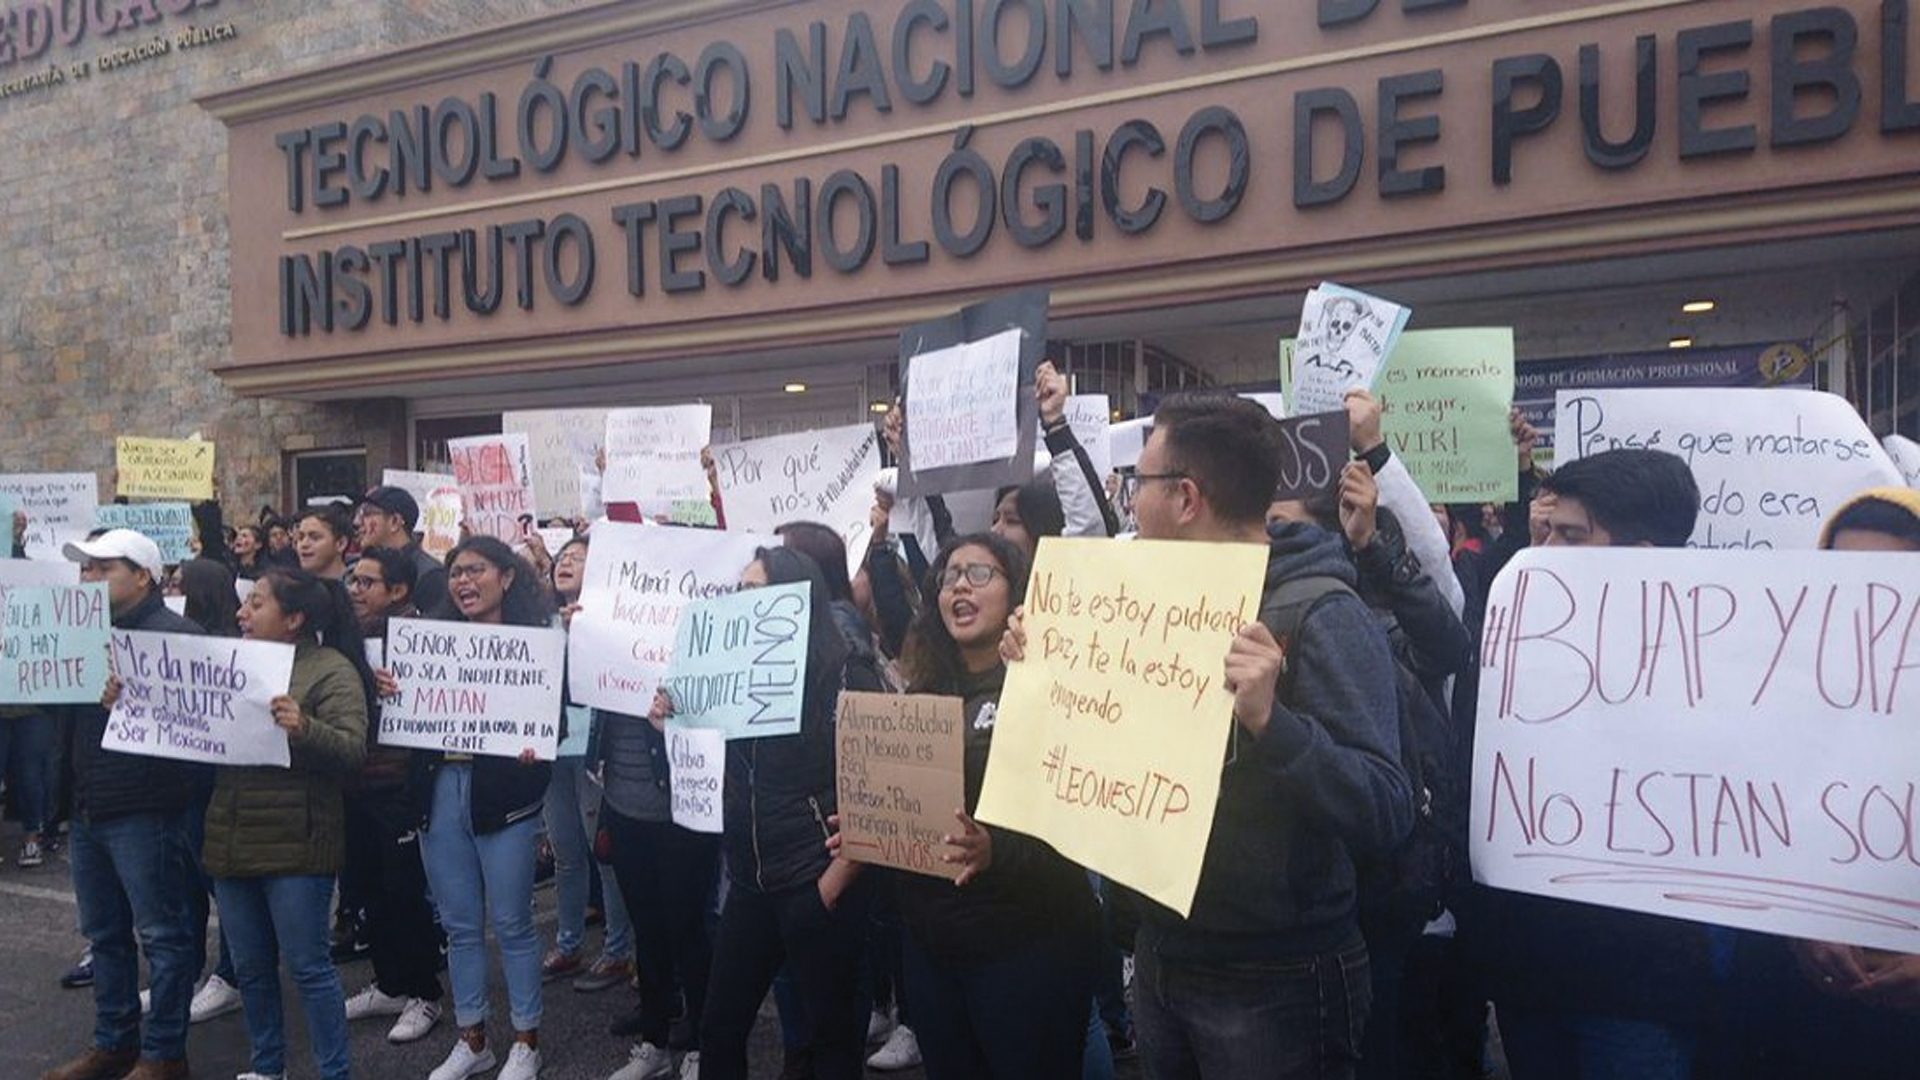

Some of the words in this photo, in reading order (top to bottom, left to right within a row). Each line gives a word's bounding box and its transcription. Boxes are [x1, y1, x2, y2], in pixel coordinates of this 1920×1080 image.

[276, 41, 750, 213] TECNOLÓGICO
[279, 212, 596, 337] INSTITUTO
[612, 105, 1250, 297] TECNOLÓGICO
[1294, 69, 1445, 209] DE
[1417, 359, 1501, 380] momento
[1570, 366, 1645, 384] FORMACIÓN
[1649, 360, 1739, 380] PROFESIONAL
[1678, 433, 1732, 465] que
[1746, 415, 1871, 461] matarse
[783, 442, 821, 492] qué
[770, 491, 811, 514] nos
[1704, 479, 1744, 515] do
[1759, 492, 1820, 519] era
[51, 587, 104, 631] VIDA
[1088, 583, 1156, 638] estoy
[30, 632, 60, 659] HAY
[688, 611, 713, 658] Ni
[723, 615, 750, 651] un
[1483, 567, 1738, 725] #BUAP
[1752, 585, 1809, 706] Y
[18, 657, 85, 696] REPITE
[112, 633, 151, 678] Me
[157, 638, 183, 684] da
[190, 648, 248, 691] miedo
[391, 660, 413, 680] NO
[418, 661, 447, 681] SEA
[747, 592, 805, 725] MENOS
[1088, 630, 1110, 675] te
[1119, 637, 1137, 676] la
[1142, 652, 1211, 712] estoy
[124, 698, 146, 720] Ser
[163, 683, 235, 722] MUJER
[412, 686, 488, 717] MATAN
[899, 702, 953, 736] Estudiar
[117, 719, 149, 744] Ser
[156, 722, 227, 755] Mexicana
[381, 716, 457, 736] ESTUDIANTES
[461, 719, 478, 734] EN
[523, 722, 537, 737] DE
[541, 723, 555, 739] LA
[441, 734, 487, 751] GENTE
[842, 736, 861, 759] en
[915, 743, 935, 762] es
[893, 785, 923, 816] Para
[1604, 767, 1791, 859] ESTAN
[877, 835, 937, 872] VIVOS
